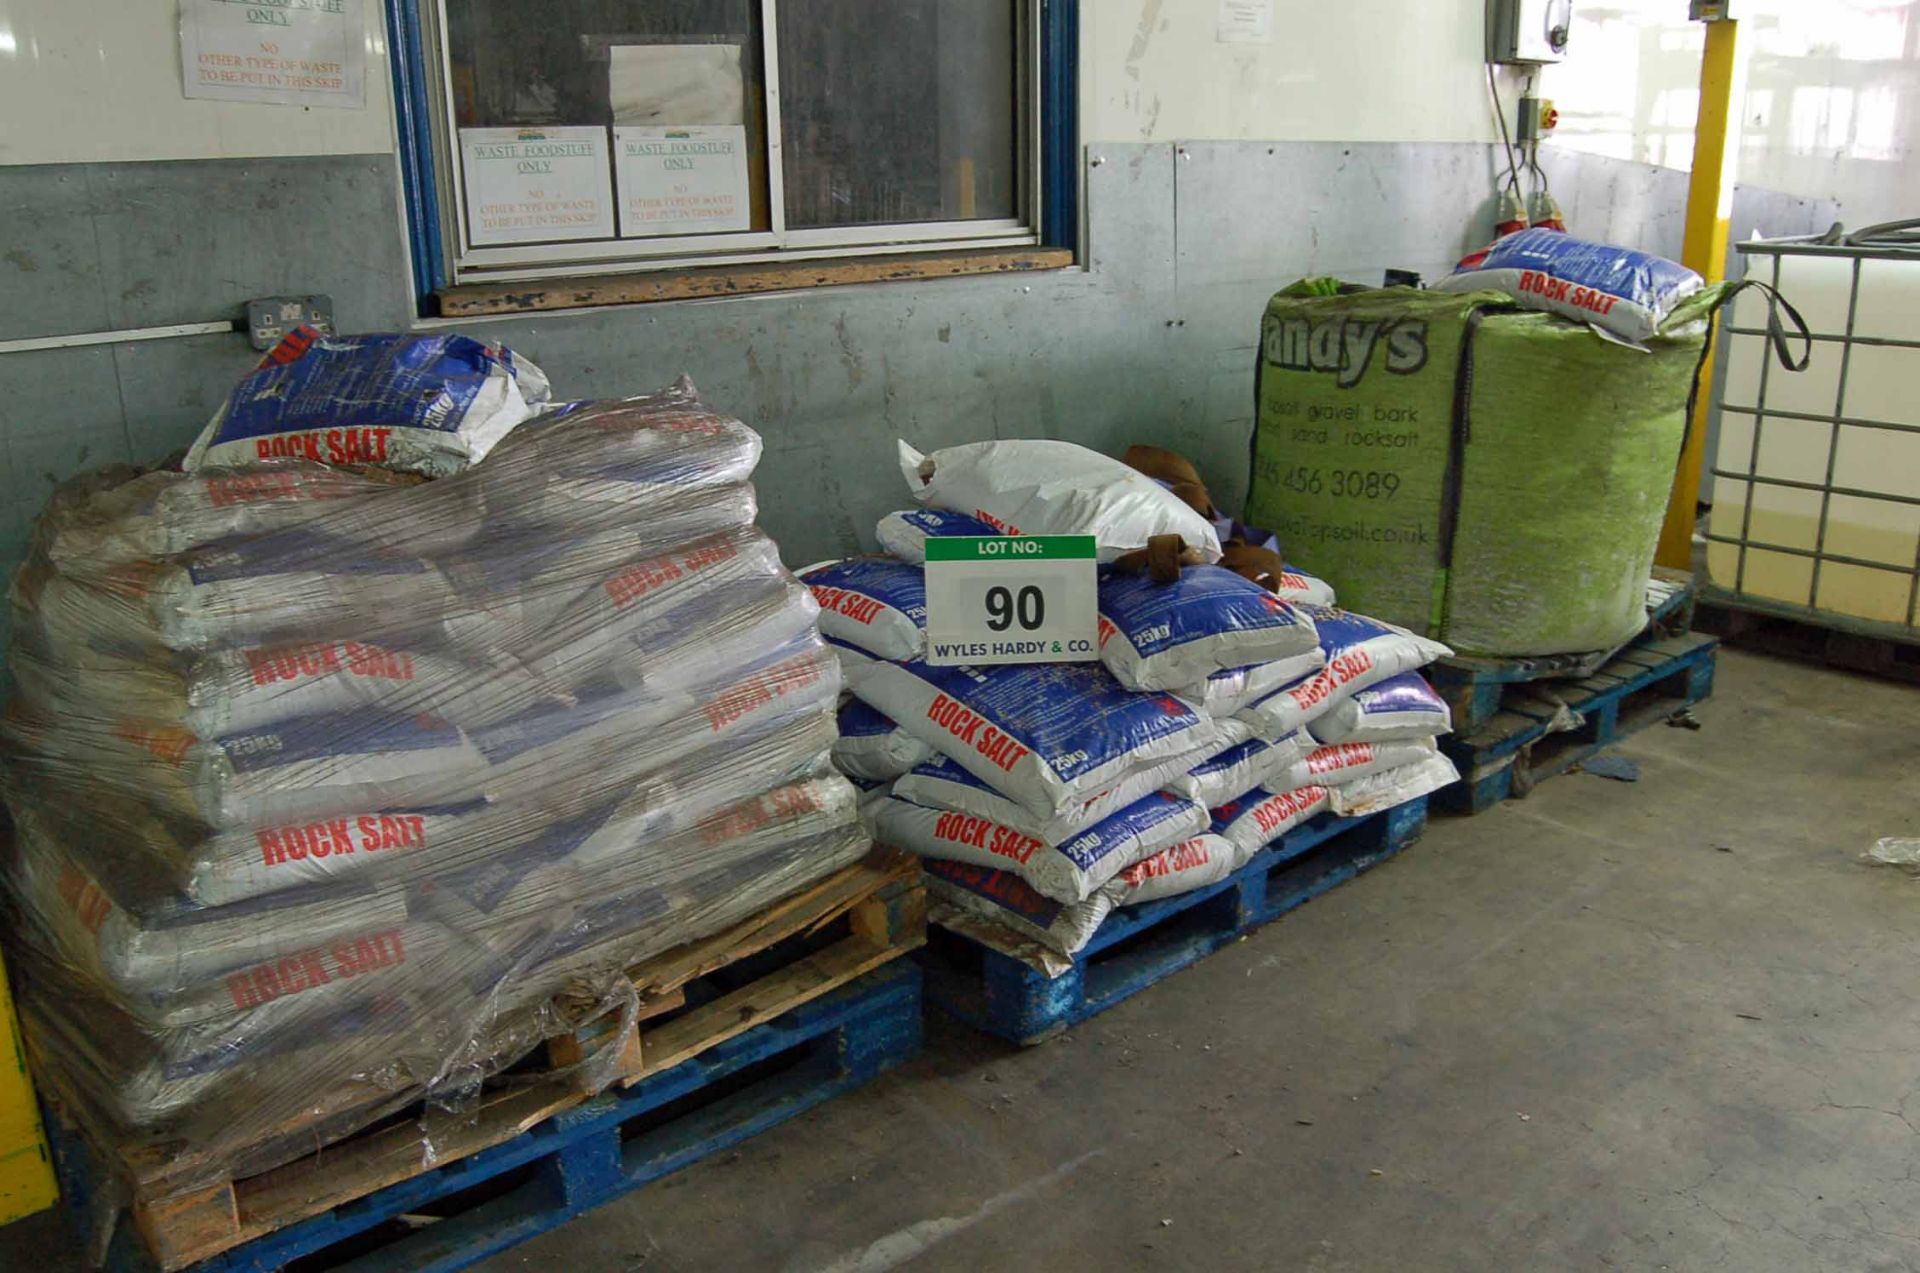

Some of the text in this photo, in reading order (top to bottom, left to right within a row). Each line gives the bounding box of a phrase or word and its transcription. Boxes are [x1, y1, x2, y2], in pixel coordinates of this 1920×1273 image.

[247, 9, 288, 23] ONLY
[260, 42, 278, 54] NO
[198, 54, 242, 66] OTHER
[246, 57, 278, 70] TYPE
[299, 61, 342, 74] WASTE
[199, 69, 219, 80] TO
[286, 75, 312, 88] THIS
[315, 78, 342, 89] SKIP
[475, 144, 516, 157] WASTE
[626, 143, 666, 154] WASTE
[517, 161, 551, 173] ONLY
[664, 158, 694, 170] ONLY
[1519, 272, 1619, 316] ROCK SALT
[1308, 404, 1360, 422] gravel
[1374, 406, 1420, 423] bark
[256, 428, 392, 465] ROCK SALT
[1344, 430, 1420, 448] rocksalt
[1331, 470, 1401, 499] 3089
[978, 542, 1043, 554] LOT NO:
[841, 594, 886, 625] SALT
[985, 585, 1045, 632] 90
[1133, 622, 1170, 647] 25kg
[935, 640, 1093, 657] WYLES HARDY & CO.
[246, 640, 415, 685] ROCK SALT
[1332, 647, 1373, 682] SALT
[927, 694, 981, 745] ROCK
[976, 723, 1030, 773] SALT
[1253, 792, 1297, 833] ROCK
[256, 816, 426, 866] ROCK SALT
[934, 812, 1044, 866] ROCK SALT
[224, 928, 407, 1009] ROCK SALT
